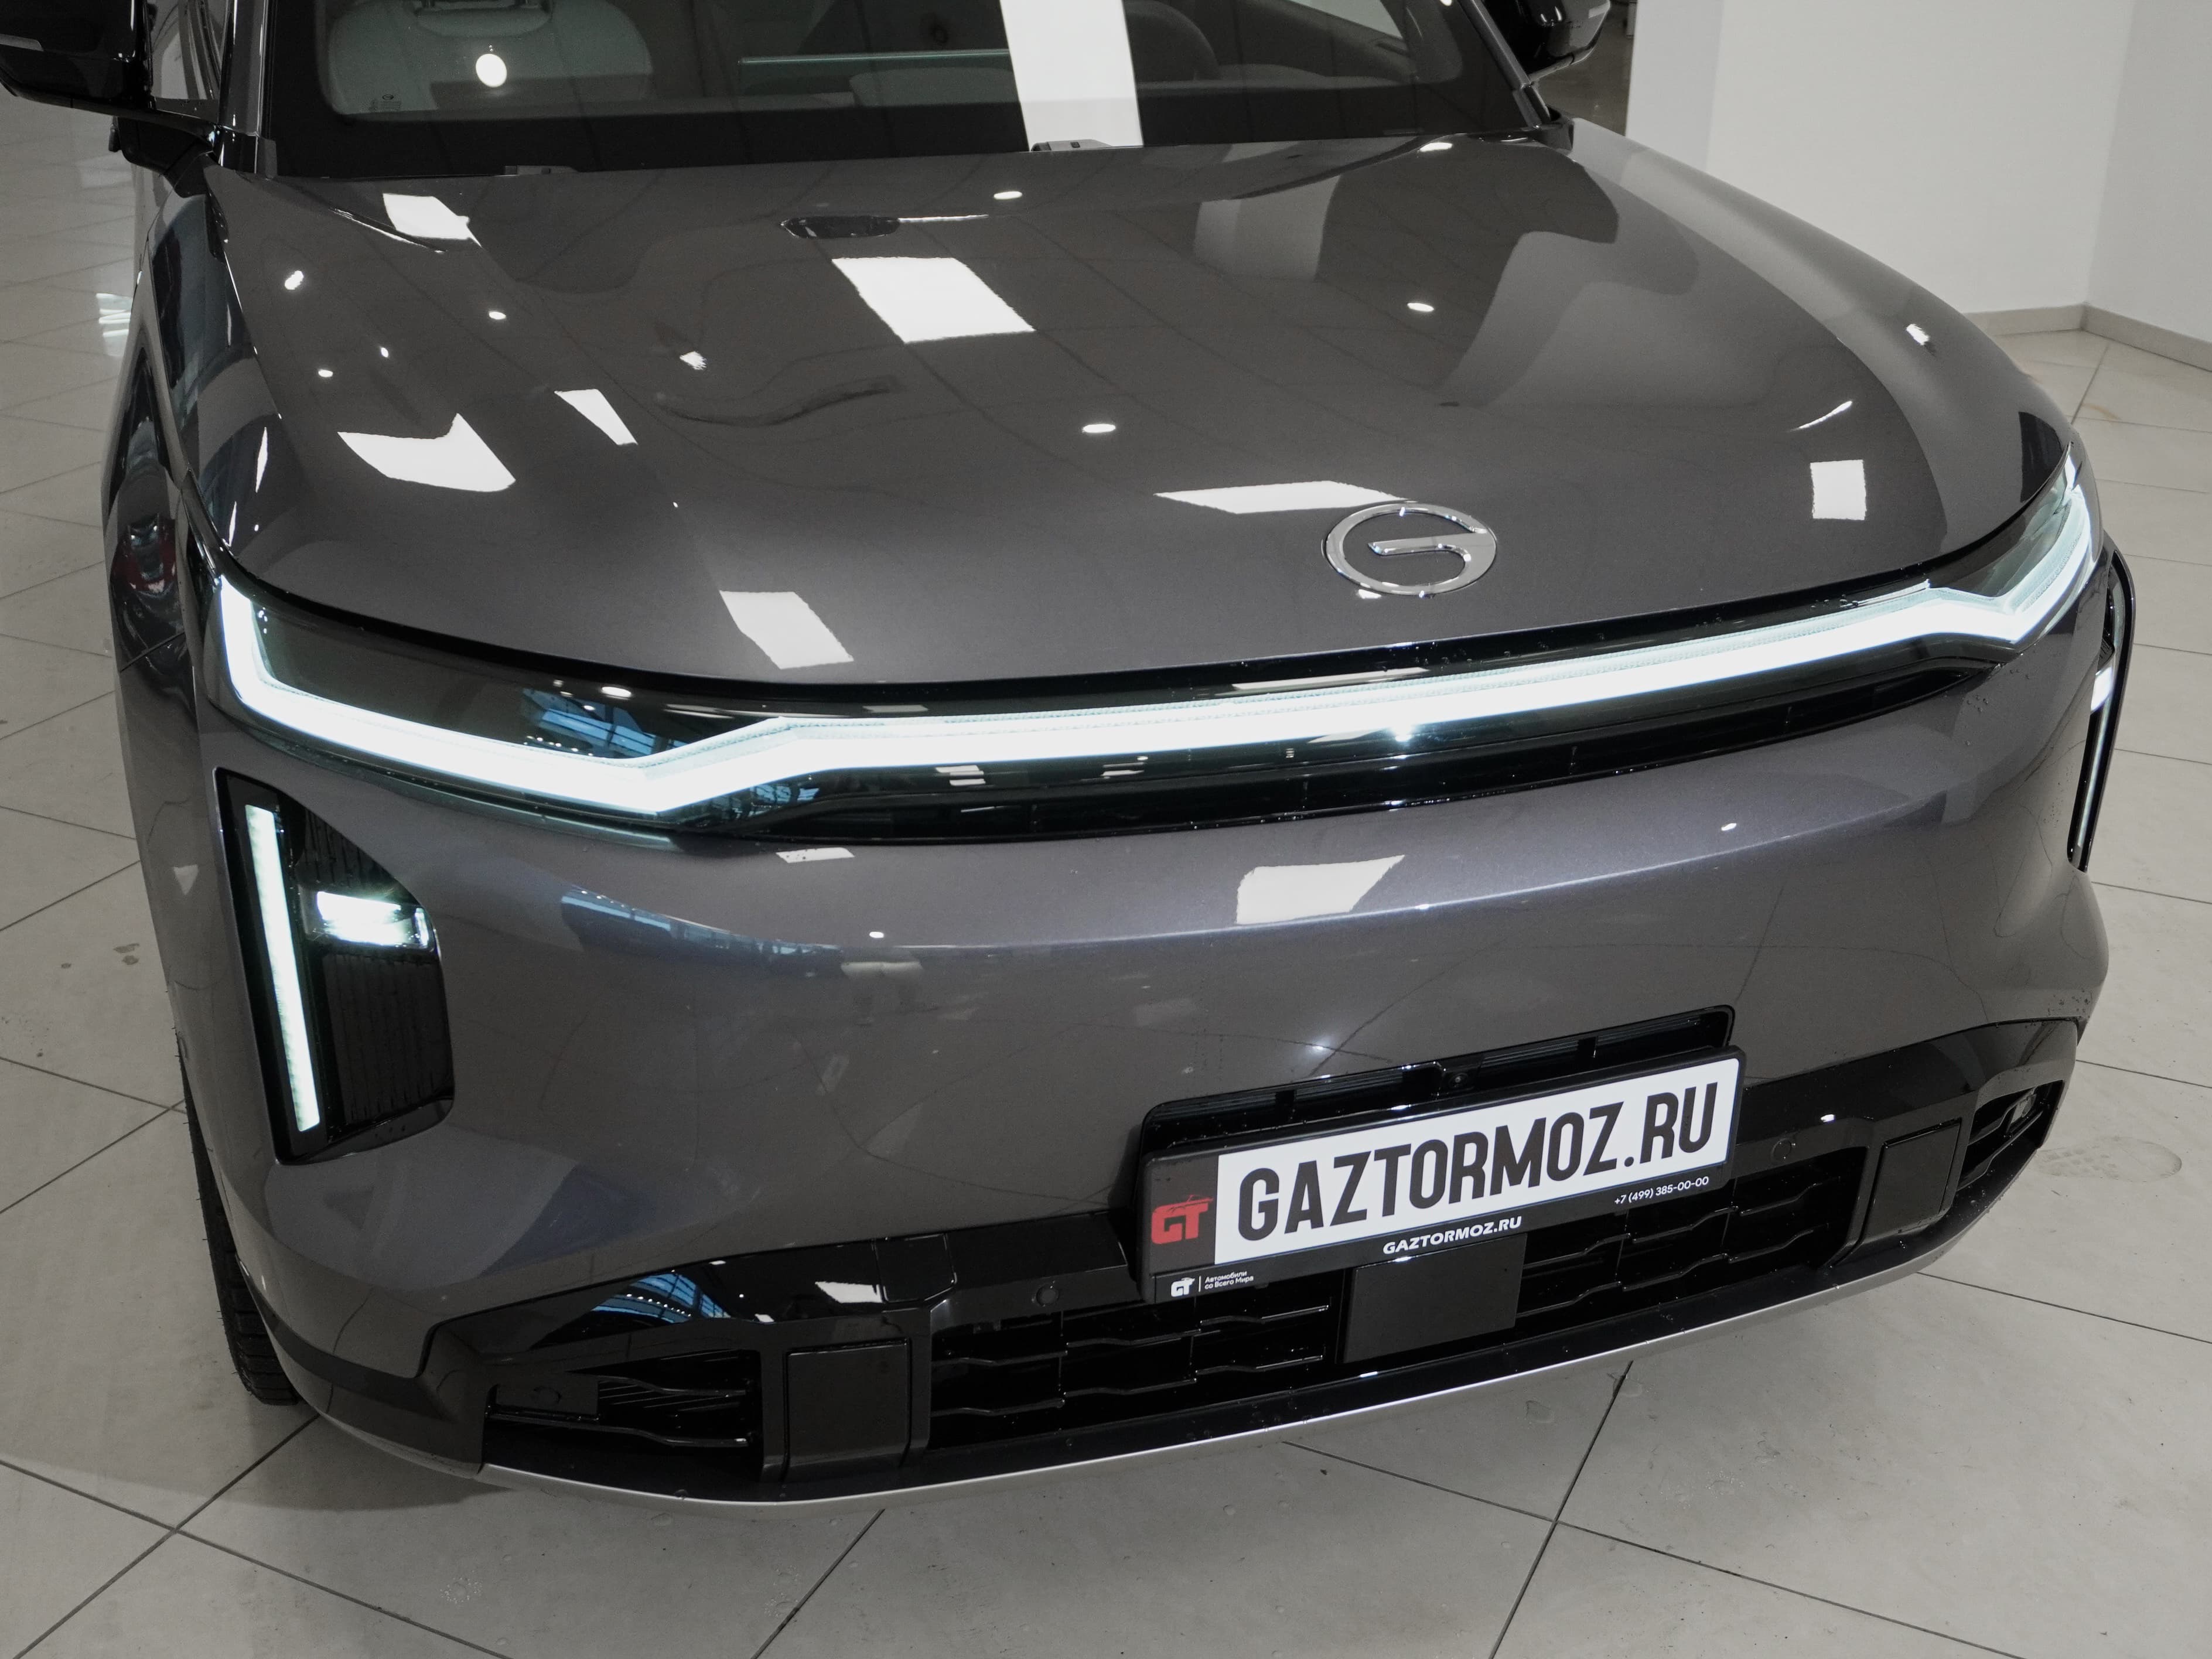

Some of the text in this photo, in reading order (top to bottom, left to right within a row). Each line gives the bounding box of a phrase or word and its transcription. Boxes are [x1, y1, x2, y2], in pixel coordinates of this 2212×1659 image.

[1238, 1082, 1719, 1241] GAZTORMOZ.RU
[1614, 1176, 1709, 1204] +7 (499) 385-00-00
[1151, 1195, 1213, 1244] GT
[1383, 1216, 1522, 1255] GAZTORMOZ.RU
[1170, 1277, 1196, 1297] GT
[1204, 1271, 1247, 1283] Автомобили
[1214, 1279, 1234, 1288] Всего
[1235, 1275, 1254, 1285] Мира
